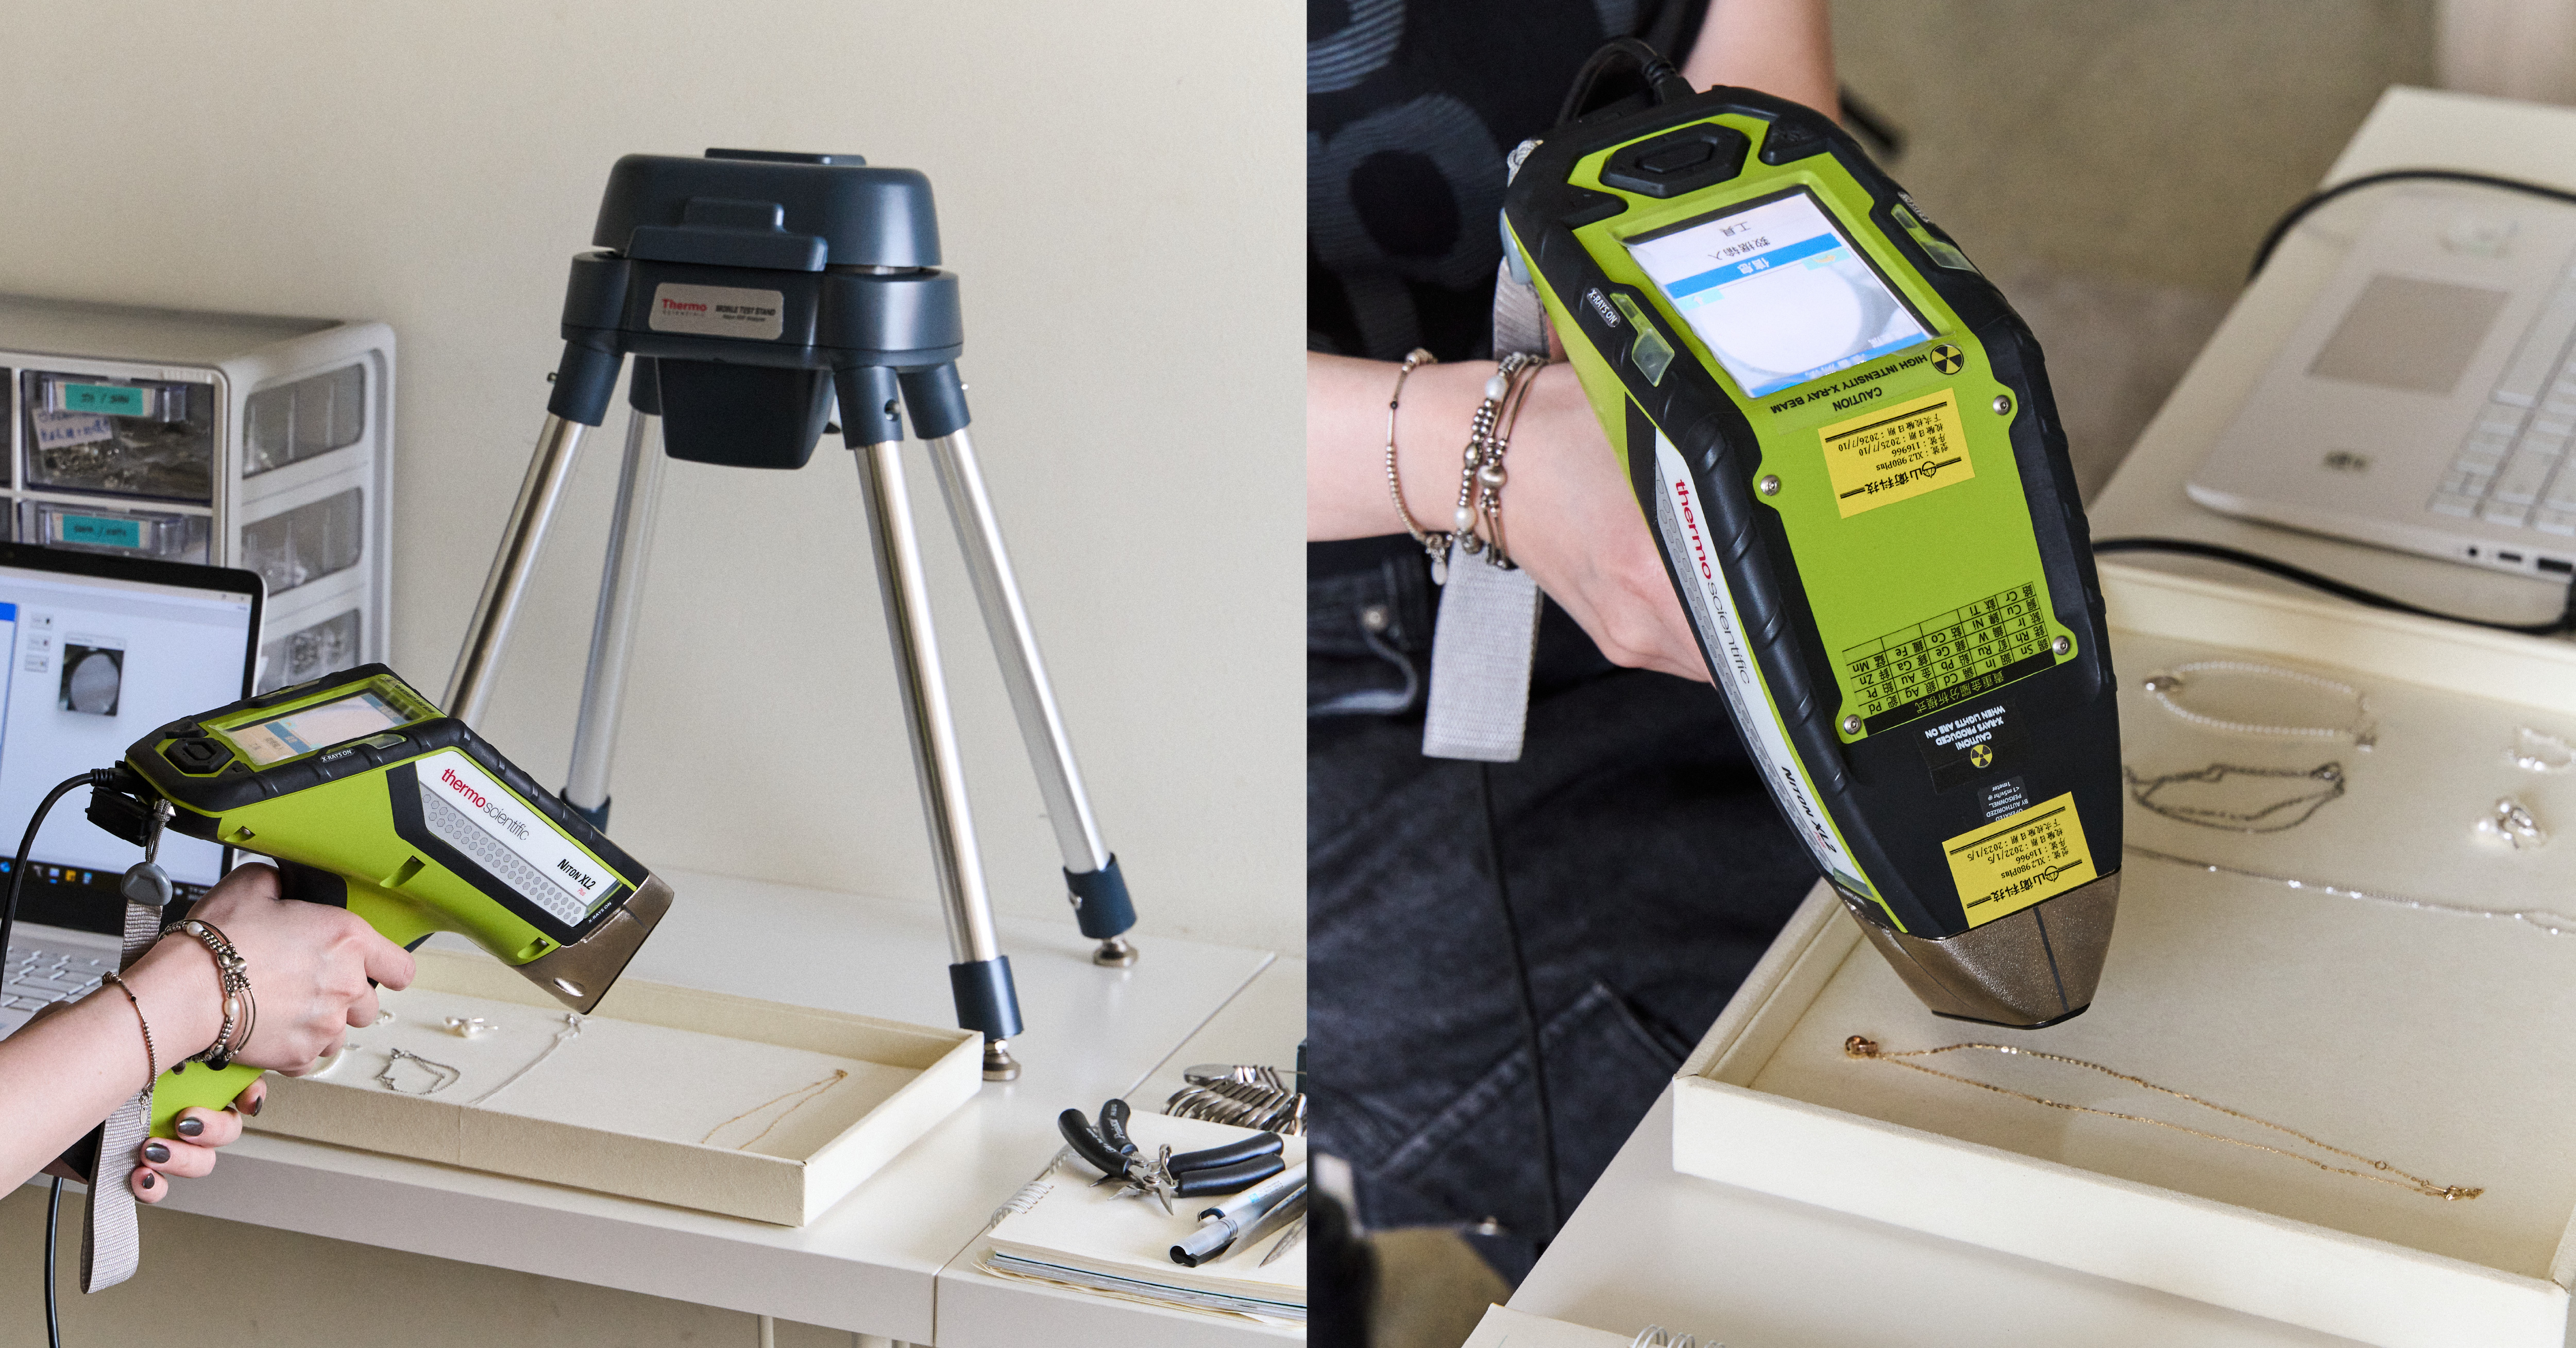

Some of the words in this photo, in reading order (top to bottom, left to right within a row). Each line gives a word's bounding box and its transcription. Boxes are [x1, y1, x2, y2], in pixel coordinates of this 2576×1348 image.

[1720, 221, 1749, 237] 工具
[1708, 235, 1771, 260] 数据输入
[662, 298, 707, 312] Thermo
[1588, 289, 1609, 314] X-RAYS
[1605, 311, 1618, 323] ON
[1899, 354, 1928, 370] HIGH
[1842, 364, 1898, 390] INTENSITY
[1807, 384, 1840, 402] X-RAY
[1832, 387, 1883, 412] CAUTION
[1770, 396, 1805, 414] BEAM
[1865, 468, 1923, 495] 山衛科技
[2006, 591, 2018, 602] Cr
[2022, 584, 2033, 598] 鉻
[1969, 605, 1980, 616] Ti
[1984, 598, 1996, 611] 鈦
[2007, 604, 2022, 615] Cu
[2026, 598, 2037, 611] 銅
[1972, 618, 1984, 629] Ni
[1988, 611, 2000, 625] 鎳
[2018, 617, 2025, 627] Ir
[2029, 611, 2041, 624] 銥
[1951, 625, 1962, 639] 鈷
[1992, 625, 2004, 638] 鎢
[2015, 631, 2029, 643] Rh
[2033, 624, 2045, 637] 銠
[1931, 632, 1946, 643] Co
[1979, 632, 1989, 643] W
[1912, 640, 1924, 653] 鐵
[1955, 639, 1966, 652] 鍺
[1977, 645, 1992, 656] Ru
[1997, 638, 2008, 652] 釕
[2020, 644, 2033, 655] Sn
[2037, 638, 2048, 651] 錫
[1895, 646, 1908, 657] Fe
[1935, 646, 1950, 657] Ge
[1873, 654, 1886, 668] 錳
[1896, 660, 1912, 671] Ga
[1917, 653, 1928, 667] 鎵
[1941, 659, 1954, 671] Pb
[1958, 653, 1970, 666] 鉛
[1985, 658, 1996, 668] In
[2000, 652, 2012, 666] 銦
[1852, 660, 1870, 672] Mn
[1962, 666, 1974, 679] 鎘
[1859, 673, 1874, 685] Zn
[1879, 668, 1890, 680] 鋅
[1901, 673, 1915, 685] Au
[1920, 667, 1932, 679] 金
[1943, 673, 1958, 686] Cd
[1866, 688, 1878, 698] Pt
[1882, 681, 1894, 694] 鉑
[1904, 684, 1919, 698] Ag
[1914, 670, 2004, 714] 貴重金屬分析模式
[1924, 680, 1936, 694] 銀
[1868, 701, 1882, 714] Pd
[1886, 695, 1899, 708] 鈀
[1980, 705, 2006, 720] WHEN
[1954, 713, 1981, 729] LIGHTS
[1977, 716, 2004, 732] X-RAYS
[1925, 728, 1939, 739] ON
[1938, 722, 1954, 734] ARE
[1935, 726, 1977, 746] PRODUCED
[1955, 731, 1992, 750] CAUTION!
[321, 752, 342, 761] X-RAYS
[1992, 781, 2010, 791] 1meter
[1994, 789, 2012, 798] mSv/hr
[1989, 793, 2022, 808] PERSONNEL.
[1986, 801, 2020, 817] AUTHORIZED
[1811, 821, 1837, 853] XL2
[578, 874, 596, 890] XL2
[1990, 873, 2046, 902] 山衛科技
[578, 888, 586, 896] Plus
[588, 908, 604, 923] X-RAYS
